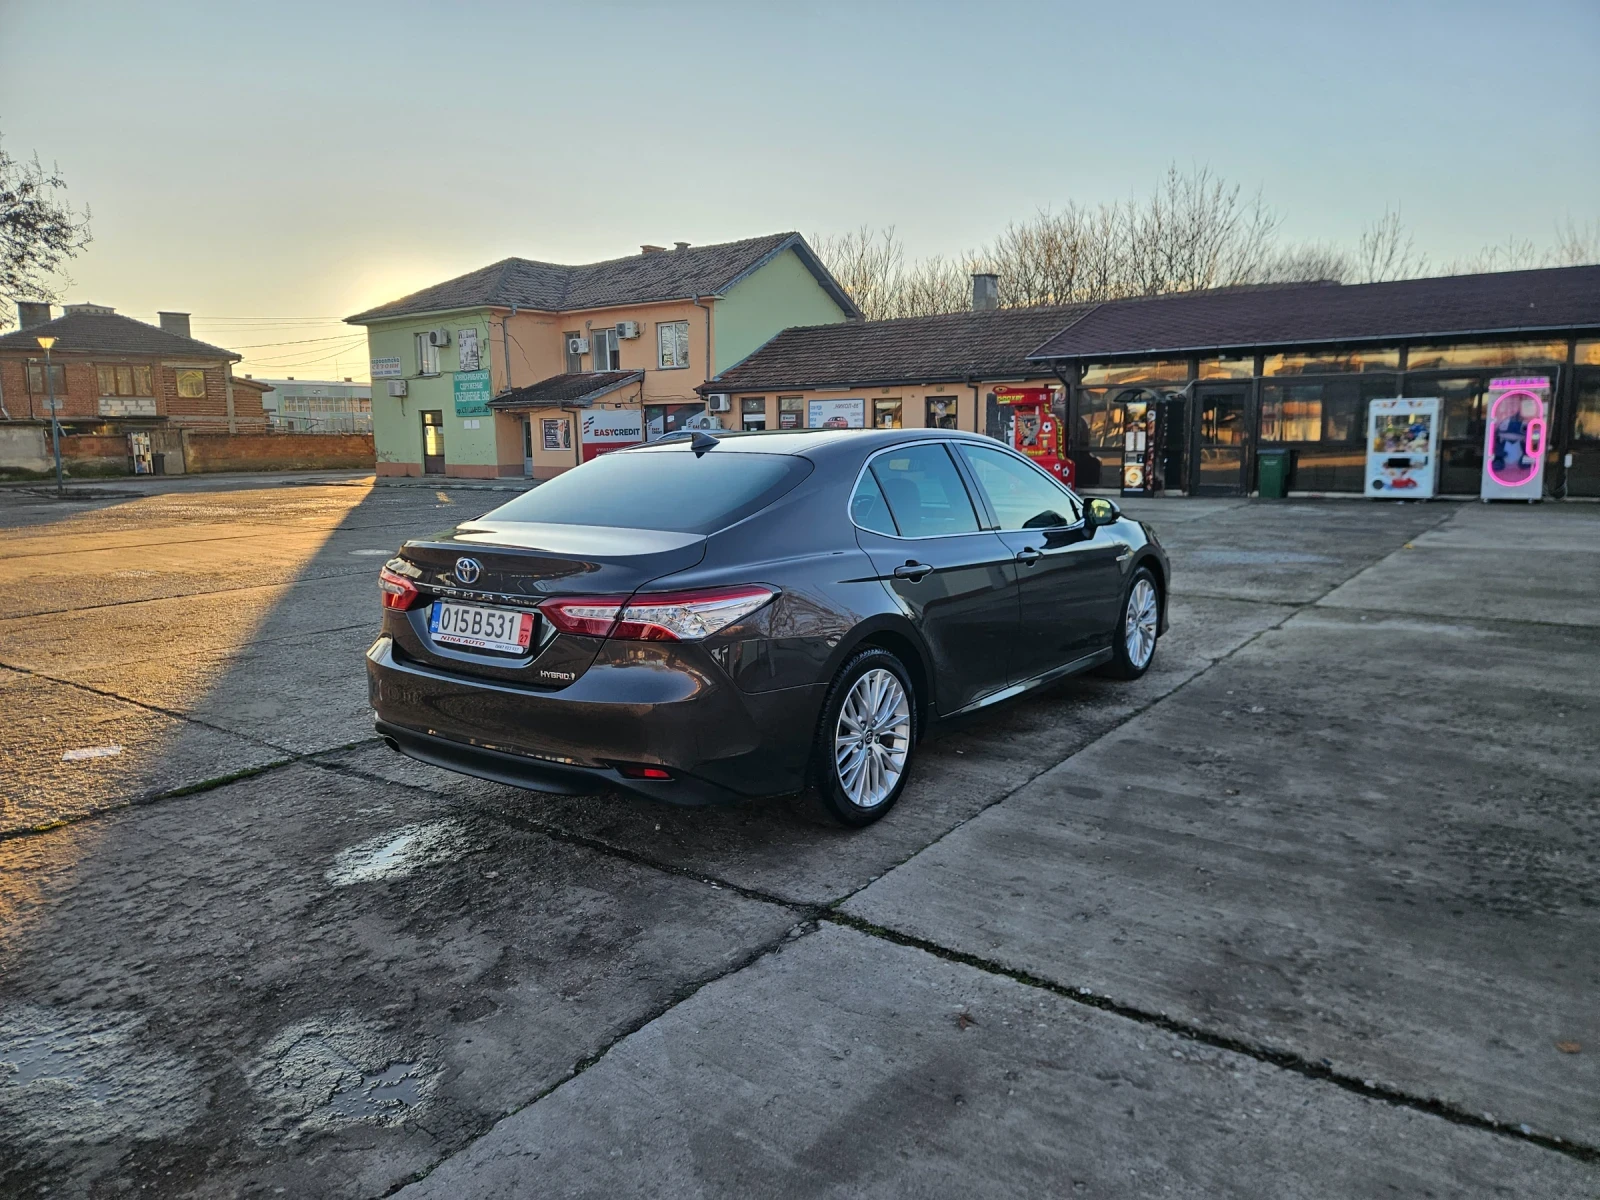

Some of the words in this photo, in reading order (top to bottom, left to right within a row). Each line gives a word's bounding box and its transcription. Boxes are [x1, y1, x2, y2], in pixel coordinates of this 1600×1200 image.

[594, 428, 640, 437] EASYCREDIT
[432, 587, 511, 600] CAMRY
[441, 607, 515, 641] 015B531
[440, 635, 461, 643] NINA
[463, 639, 485, 647] AUTO
[520, 634, 528, 643] 27
[540, 670, 570, 680] HYBRID
